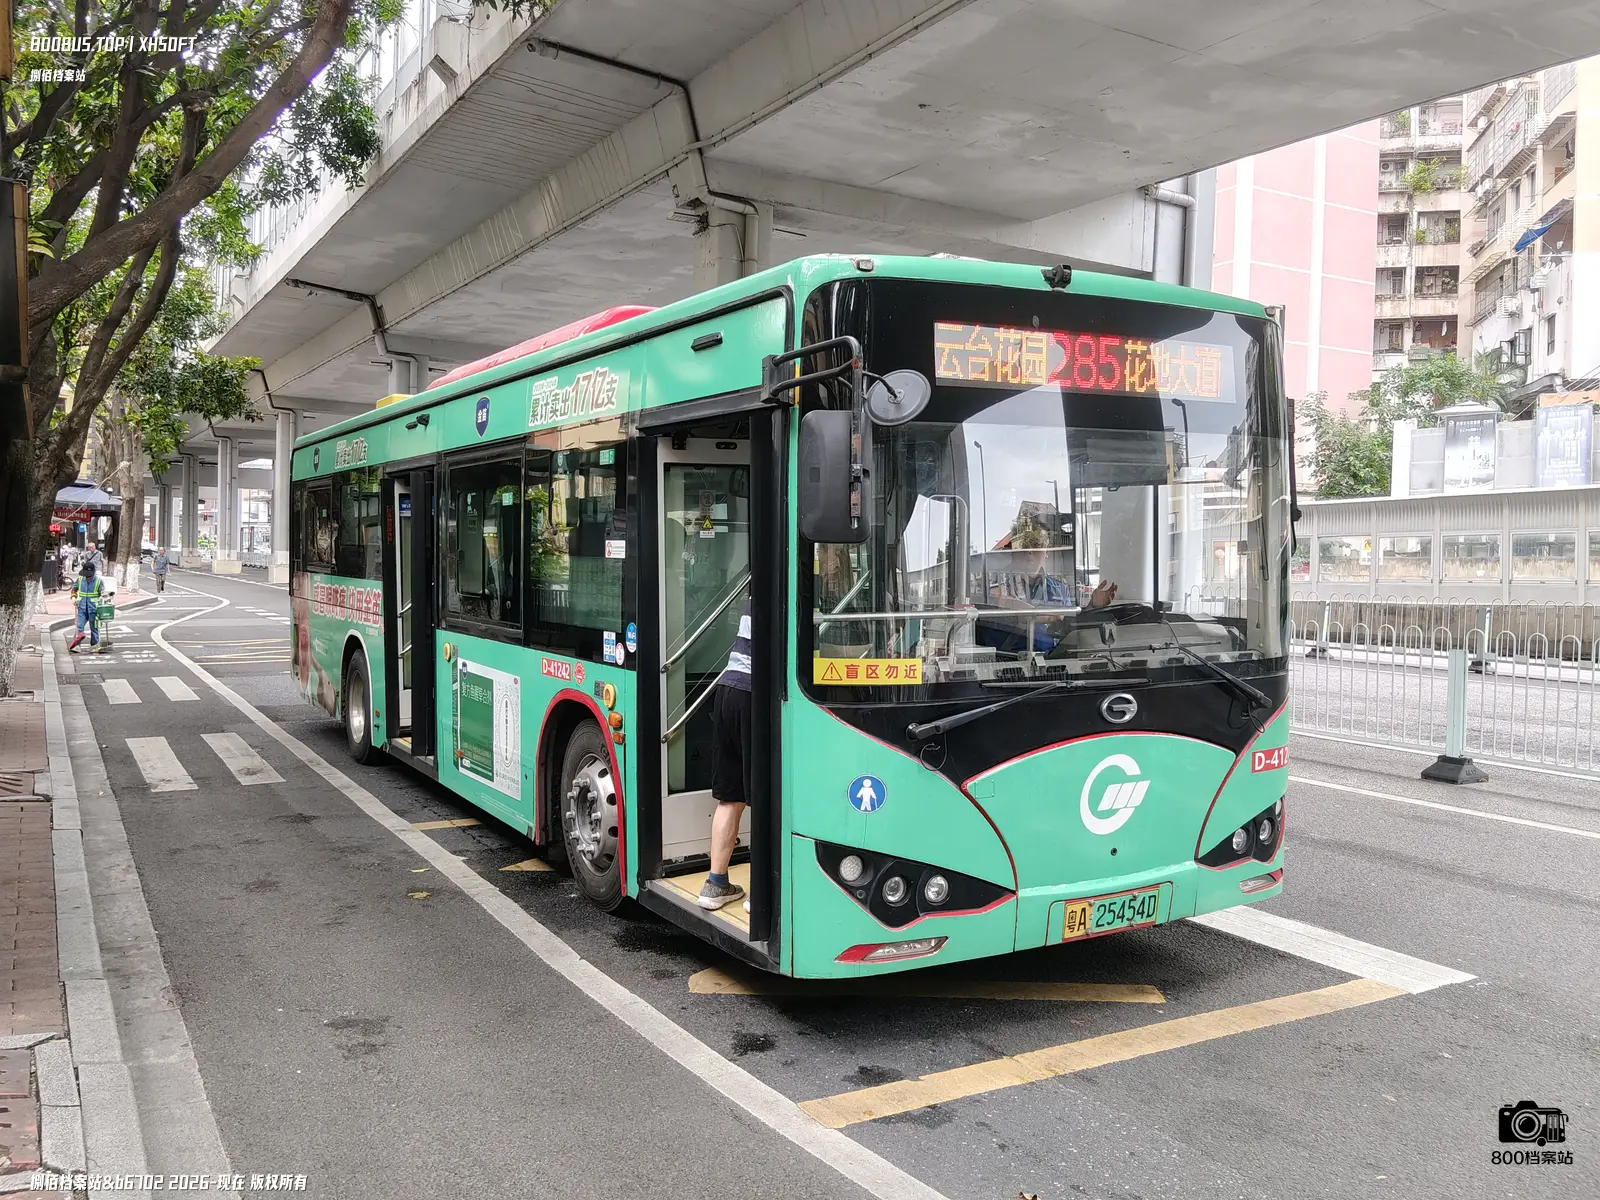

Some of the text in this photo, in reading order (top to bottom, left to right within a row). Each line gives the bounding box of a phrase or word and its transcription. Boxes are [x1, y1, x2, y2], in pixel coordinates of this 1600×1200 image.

[935, 321, 1047, 385] 云台花园
[1048, 331, 1121, 390] 285
[530, 368, 618, 426] 累计卖出17亿支
[543, 658, 570, 680] D-41242
[845, 664, 917, 679] 盲区勿近
